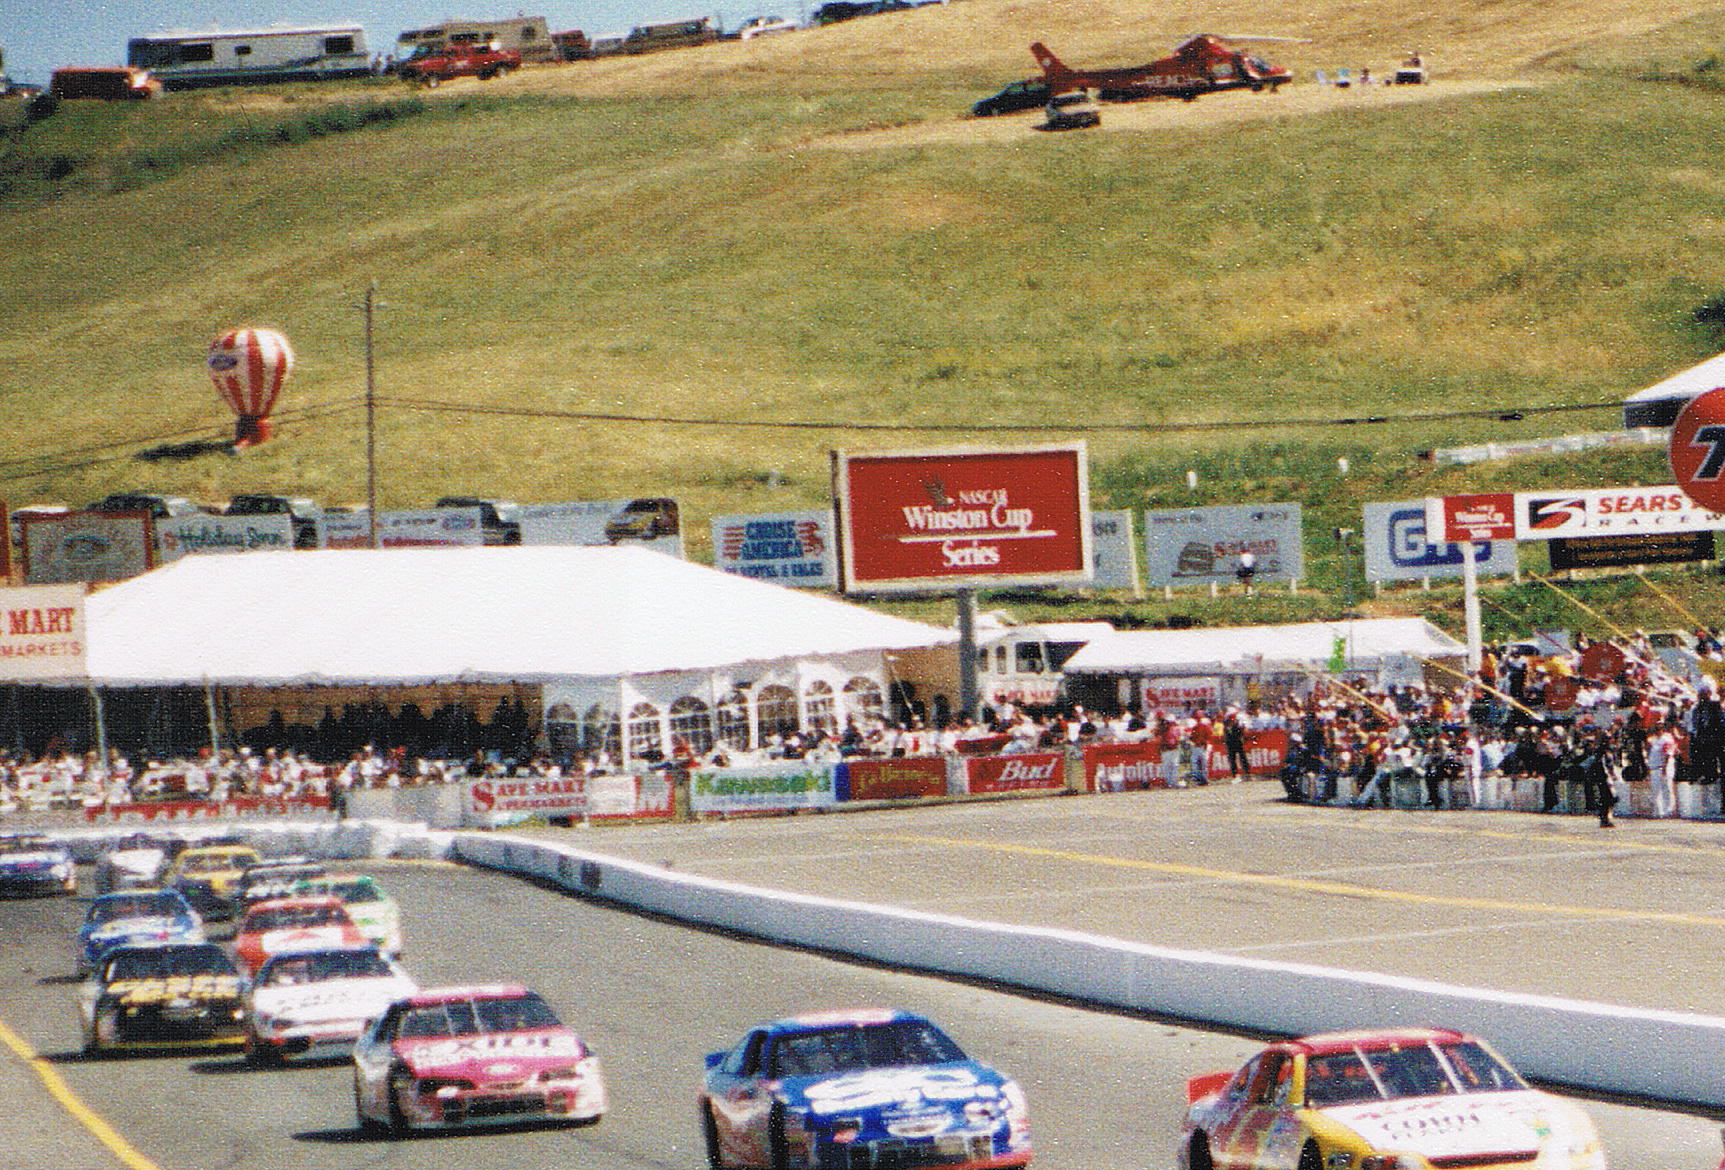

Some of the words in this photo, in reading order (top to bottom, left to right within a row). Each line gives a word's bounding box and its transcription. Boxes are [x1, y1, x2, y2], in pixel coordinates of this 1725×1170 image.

[959, 489, 1008, 506] NASCAR
[1598, 495, 1683, 515] SEARS
[902, 505, 989, 530] Winston
[991, 504, 1033, 535] Cup
[942, 540, 1001, 567] Series
[9, 607, 75, 635] MART
[995, 758, 1058, 782] Bud
[1212, 748, 1280, 771] Aulite
[534, 779, 586, 795] MART
